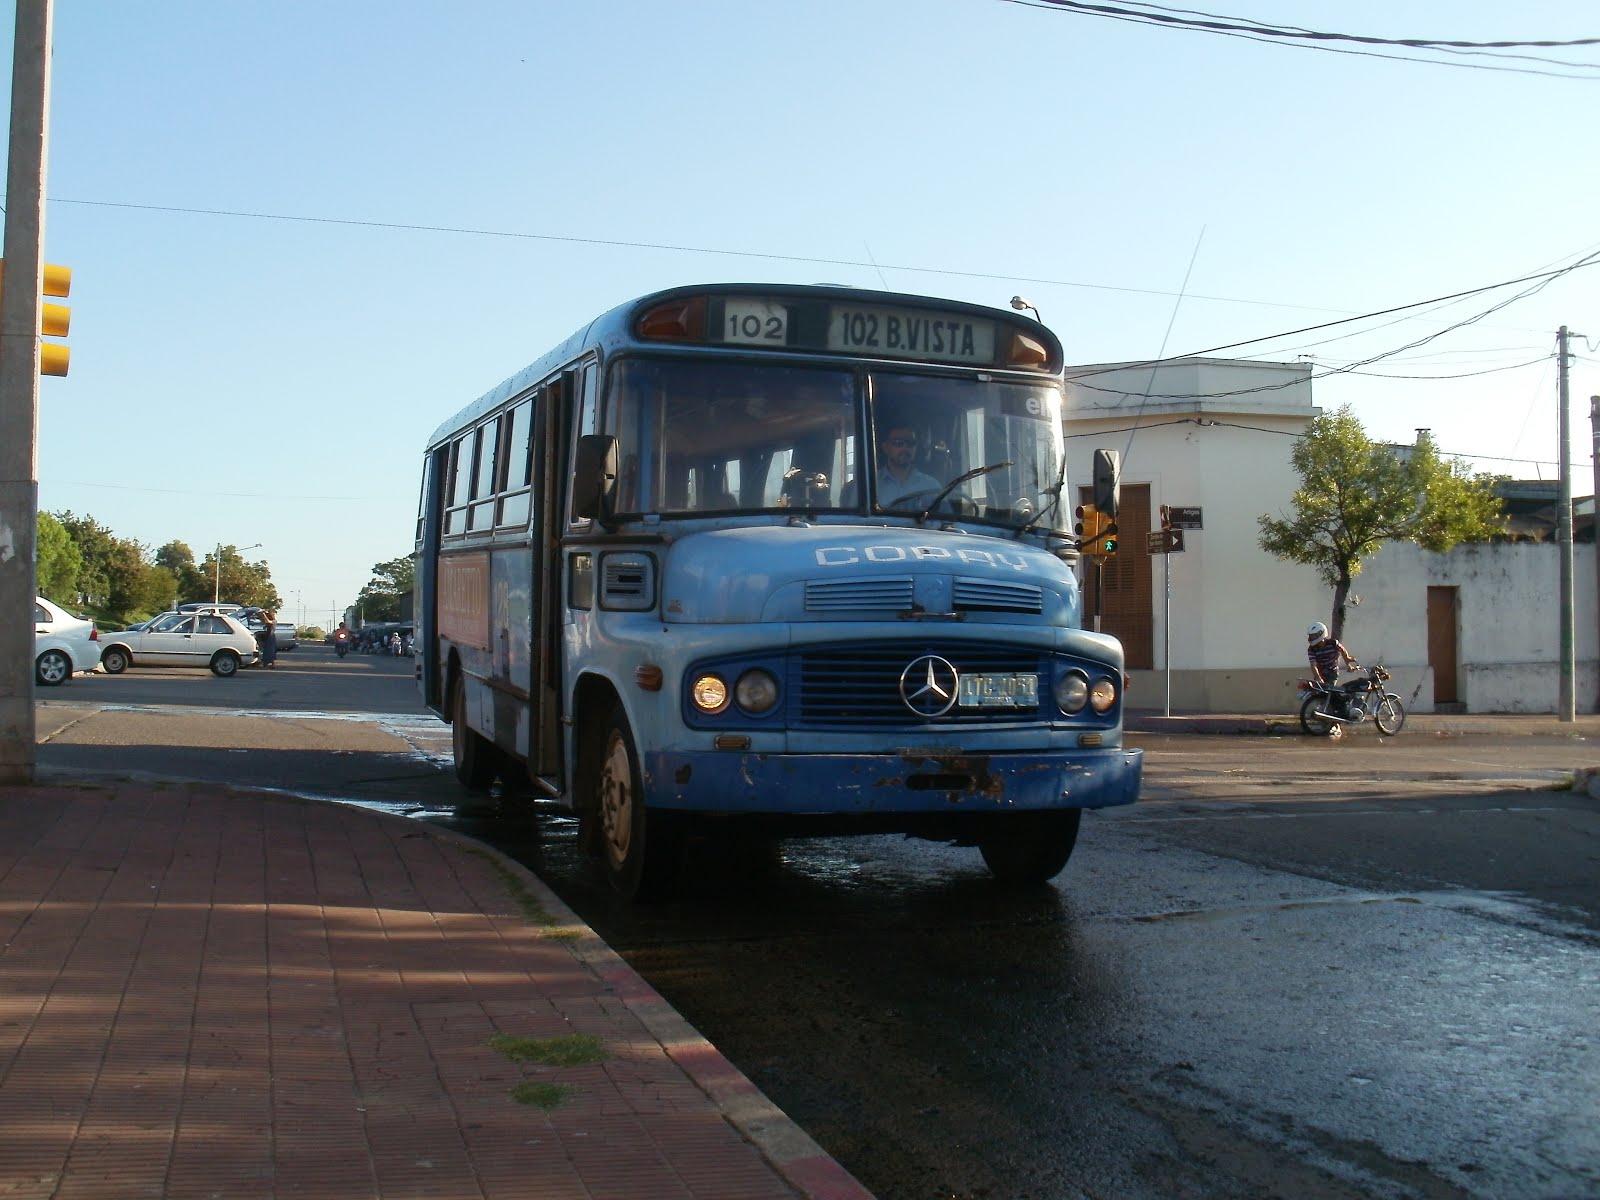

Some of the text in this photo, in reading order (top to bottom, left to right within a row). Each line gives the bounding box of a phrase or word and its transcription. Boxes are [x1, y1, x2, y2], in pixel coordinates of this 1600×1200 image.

[729, 314, 783, 340] 102
[842, 312, 976, 357] 102 B.VISTA
[1183, 509, 1200, 517] Artigas
[815, 546, 1029, 571] COPAY
